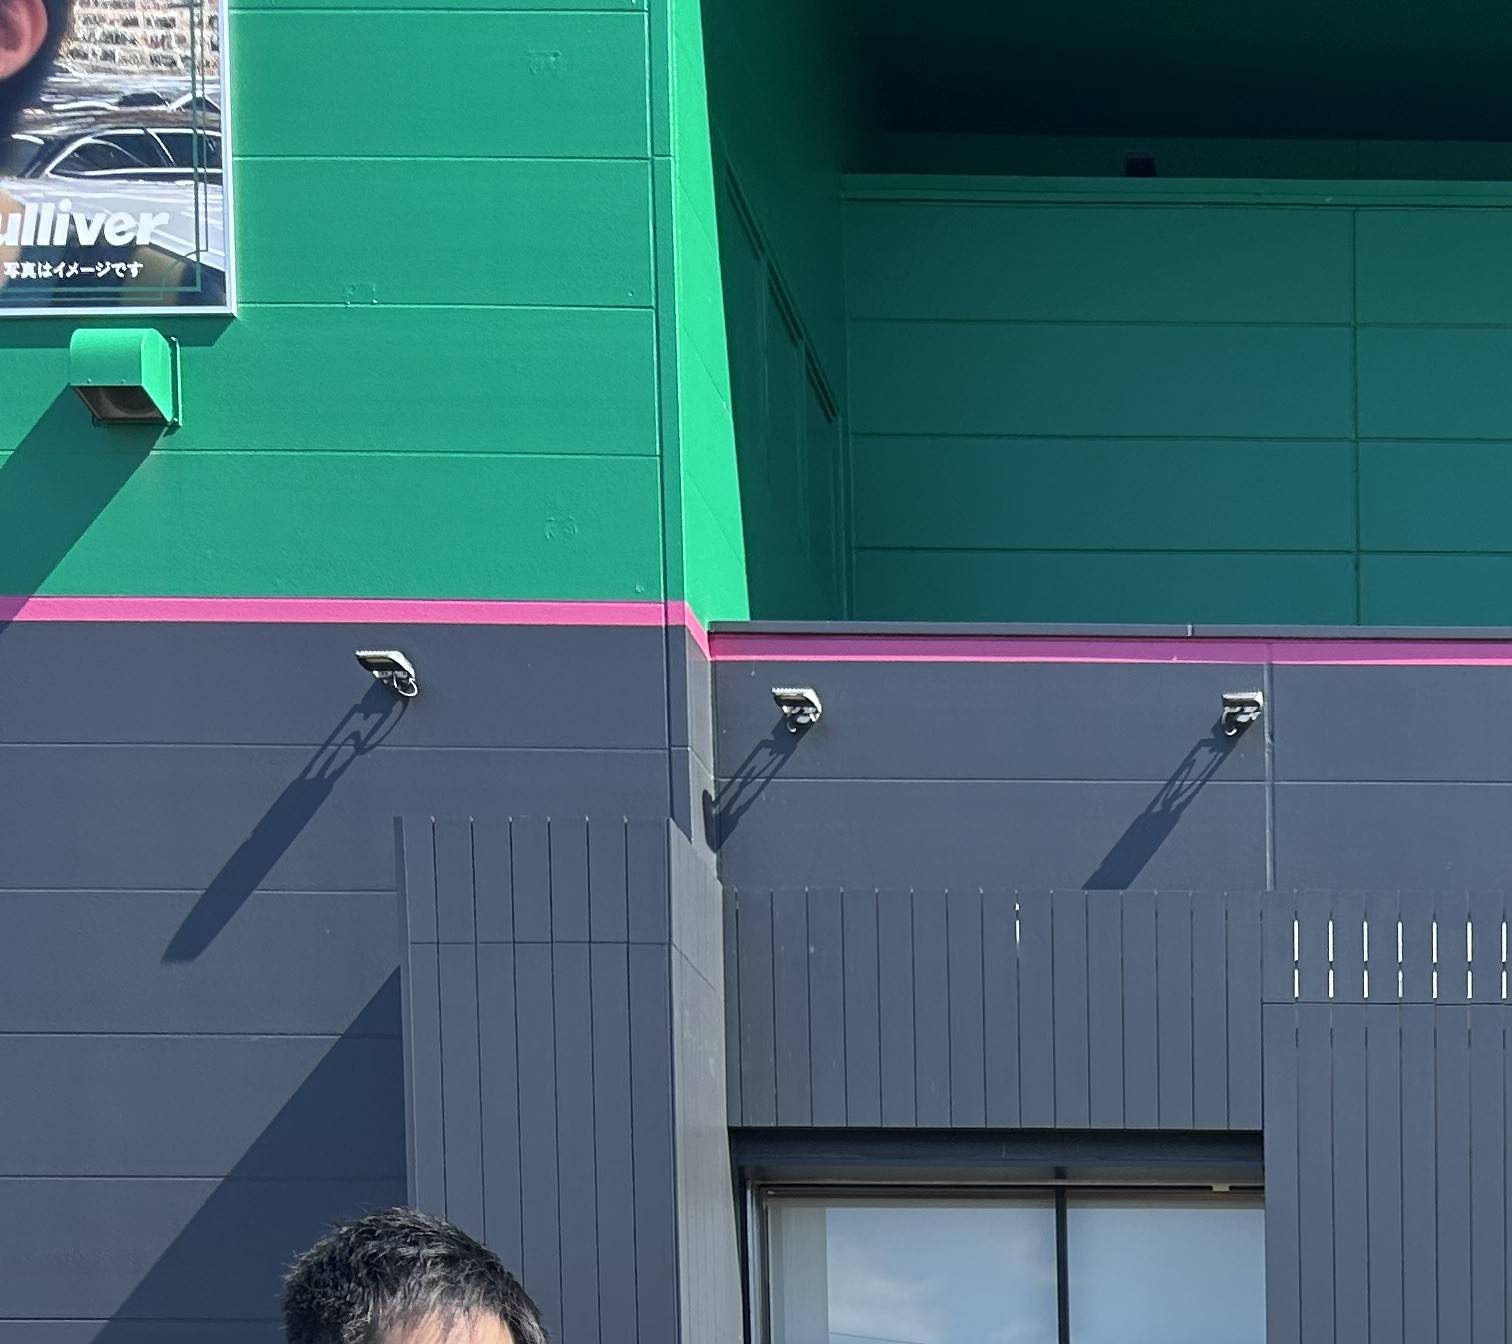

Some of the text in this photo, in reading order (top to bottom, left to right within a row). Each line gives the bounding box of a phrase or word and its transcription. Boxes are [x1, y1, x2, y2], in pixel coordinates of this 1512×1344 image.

[3, 261, 144, 279] 写真はイメージです
